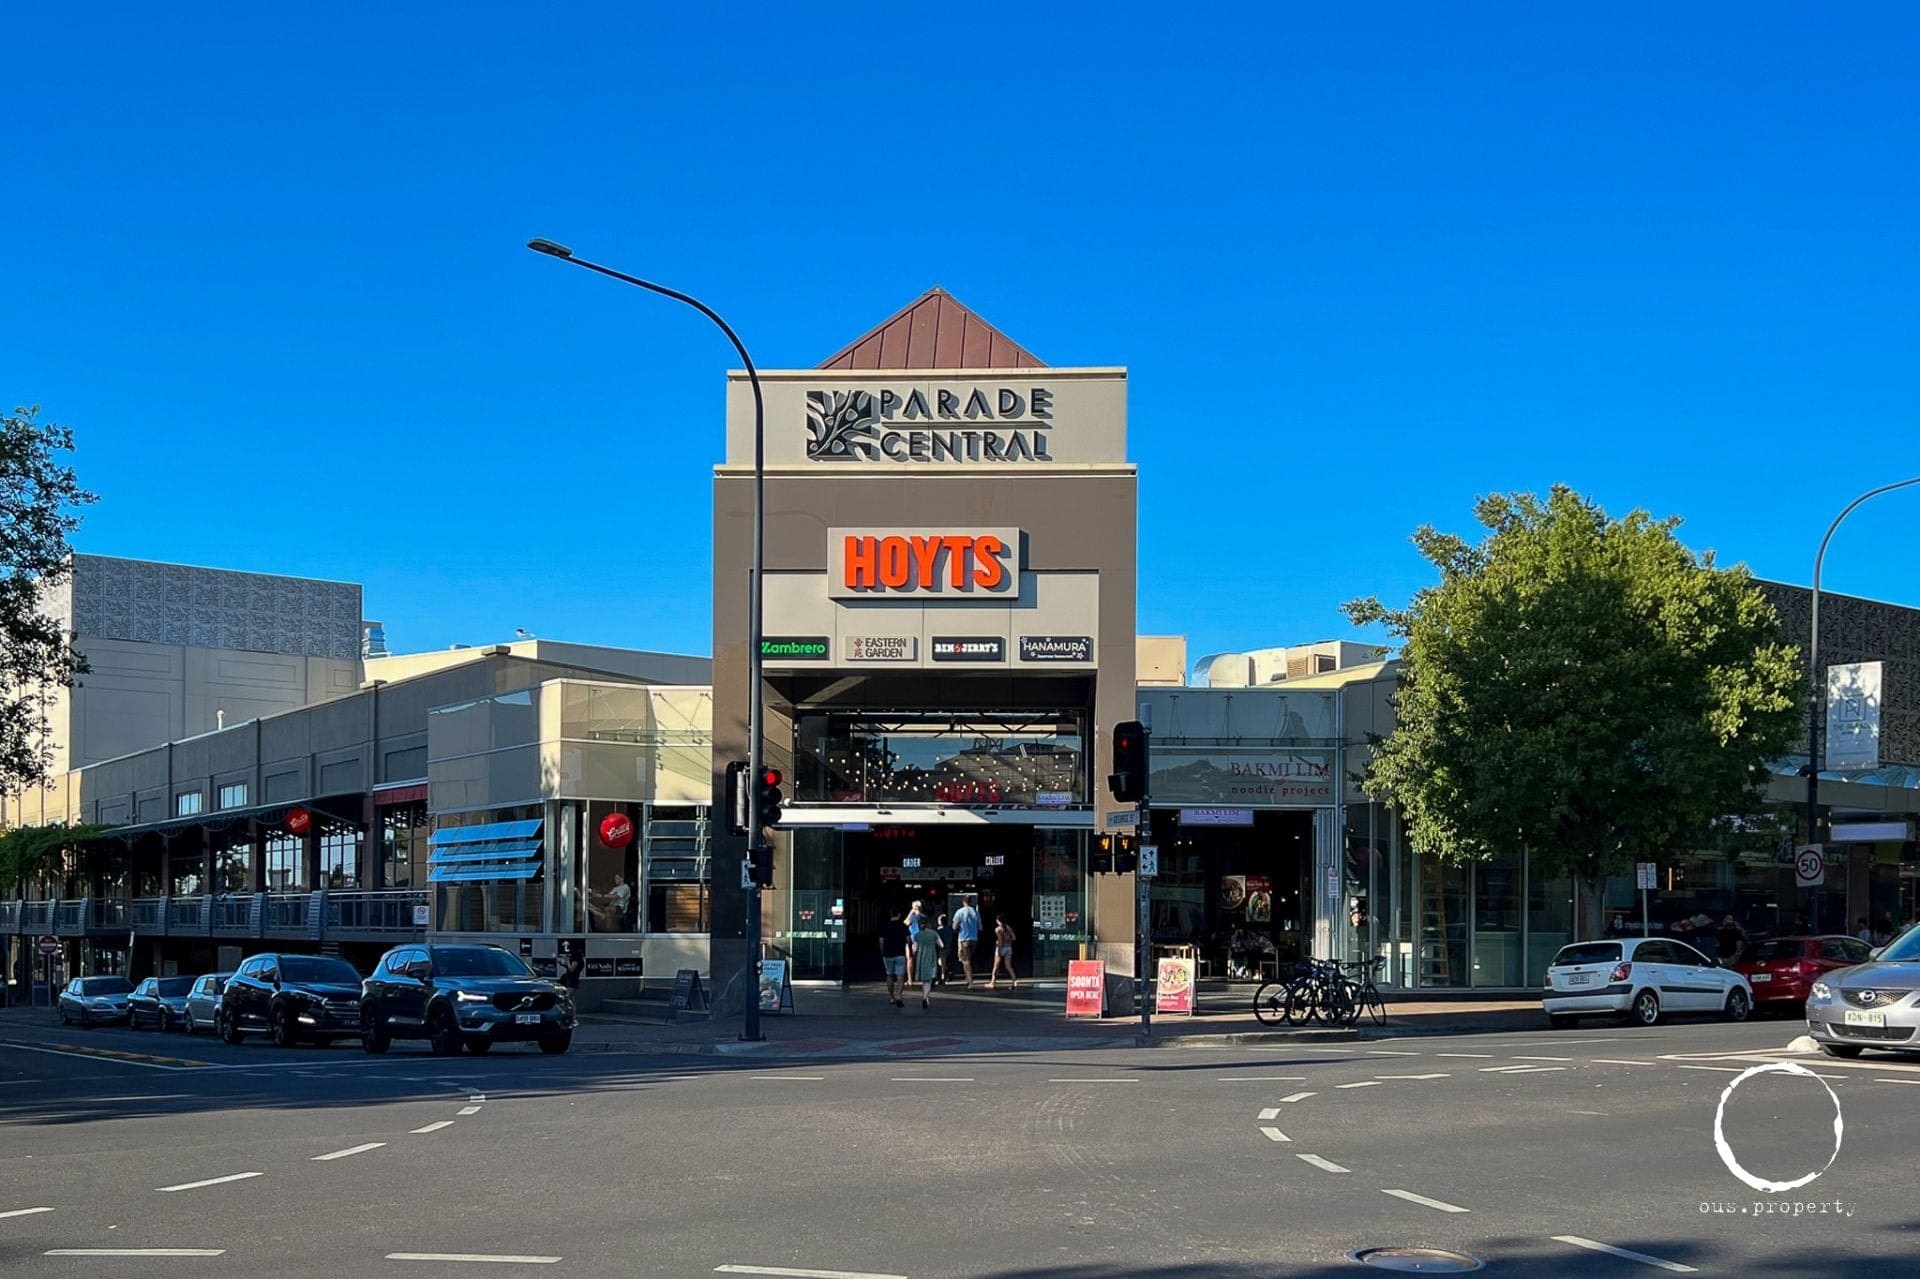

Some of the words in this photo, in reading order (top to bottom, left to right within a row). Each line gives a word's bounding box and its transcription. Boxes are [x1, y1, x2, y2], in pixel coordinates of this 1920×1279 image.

[880, 387, 1052, 417] PARADE
[880, 431, 1048, 460] CENTRAL
[844, 535, 1003, 589] HOYTS
[761, 640, 826, 655] Zambrero
[865, 637, 907, 648] EASTERN
[1023, 641, 1087, 652] HANAMURA
[865, 648, 903, 658] GARDEN
[1231, 784, 1276, 795] noodle
[1281, 785, 1329, 797] project
[1800, 858, 1819, 872] 50
[1070, 975, 1102, 988] SOONTA
